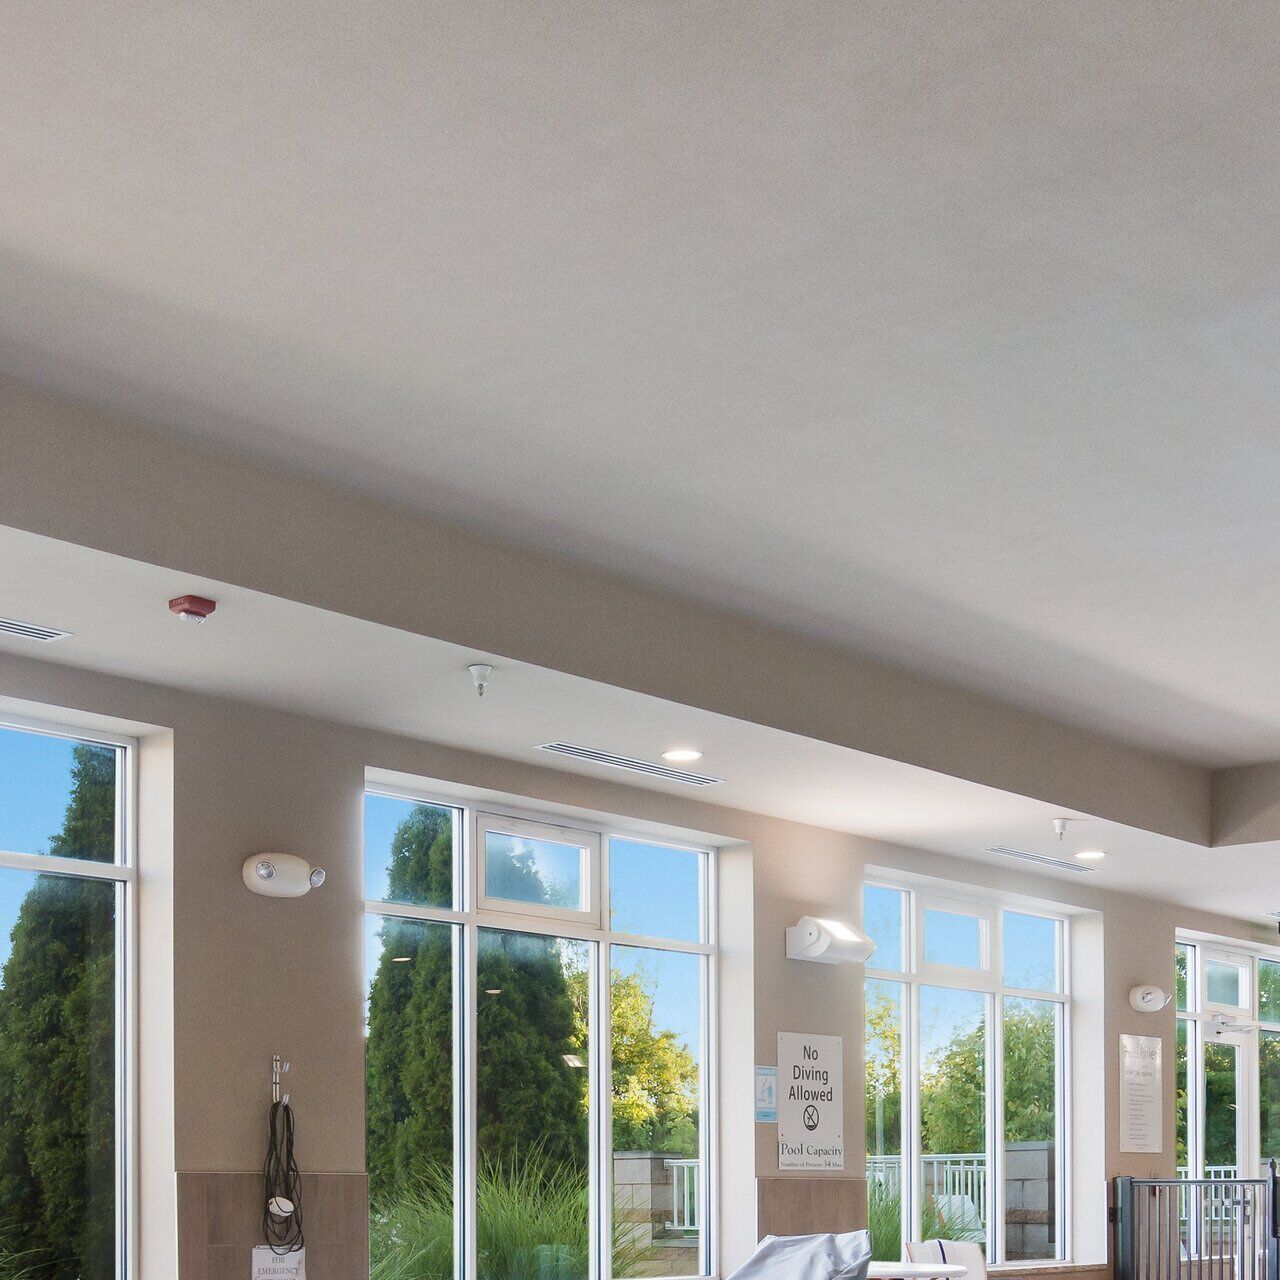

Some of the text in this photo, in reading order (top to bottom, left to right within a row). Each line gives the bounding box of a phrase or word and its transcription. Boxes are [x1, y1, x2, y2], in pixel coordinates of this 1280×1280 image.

[803, 1045, 818, 1060] No
[793, 1065, 828, 1085] Diving
[789, 1085, 832, 1101] Allowed
[781, 1143, 842, 1157] Pool Capacity
[272, 1256, 286, 1264] FOR
[257, 1267, 300, 1275] EMERGENCY
